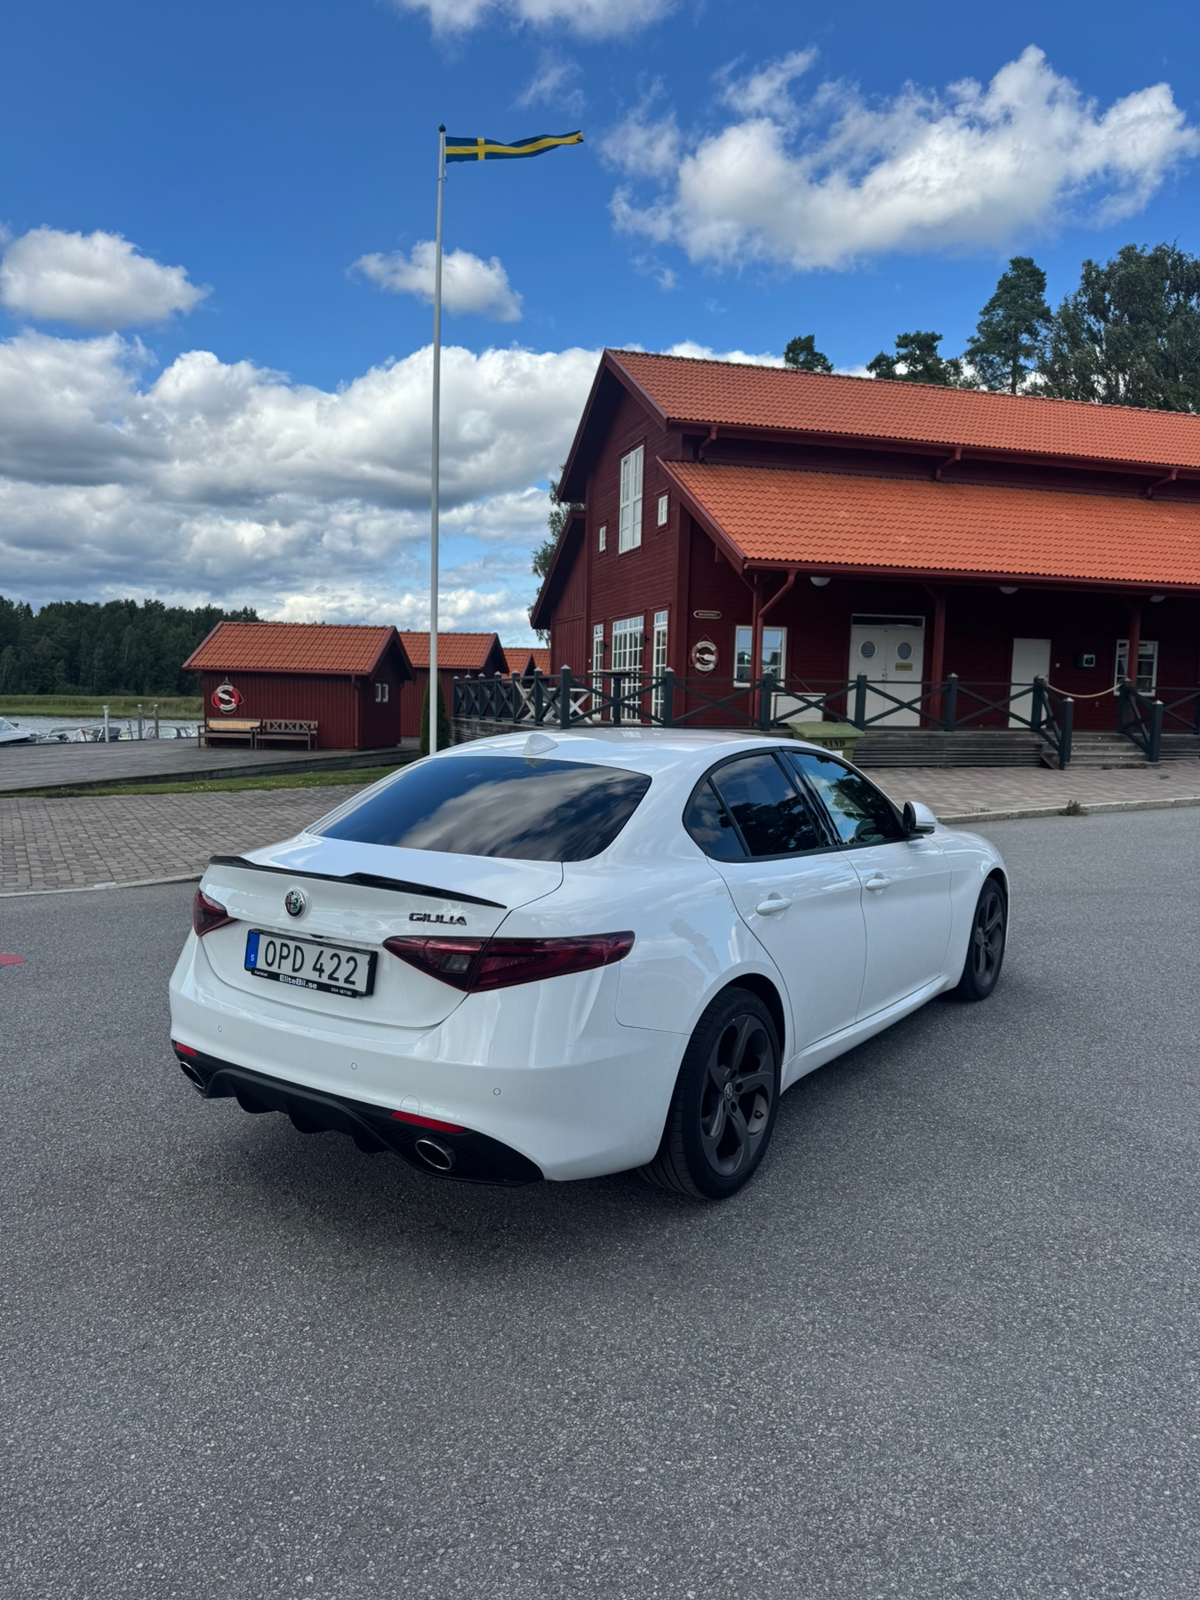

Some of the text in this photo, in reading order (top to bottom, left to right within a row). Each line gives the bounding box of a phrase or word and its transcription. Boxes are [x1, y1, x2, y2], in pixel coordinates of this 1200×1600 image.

[822, 740, 846, 748] SAND
[409, 912, 467, 926] GIULIA
[250, 954, 255, 962] S
[265, 940, 358, 986] OPD 422
[279, 974, 318, 989] EliteBil.se
